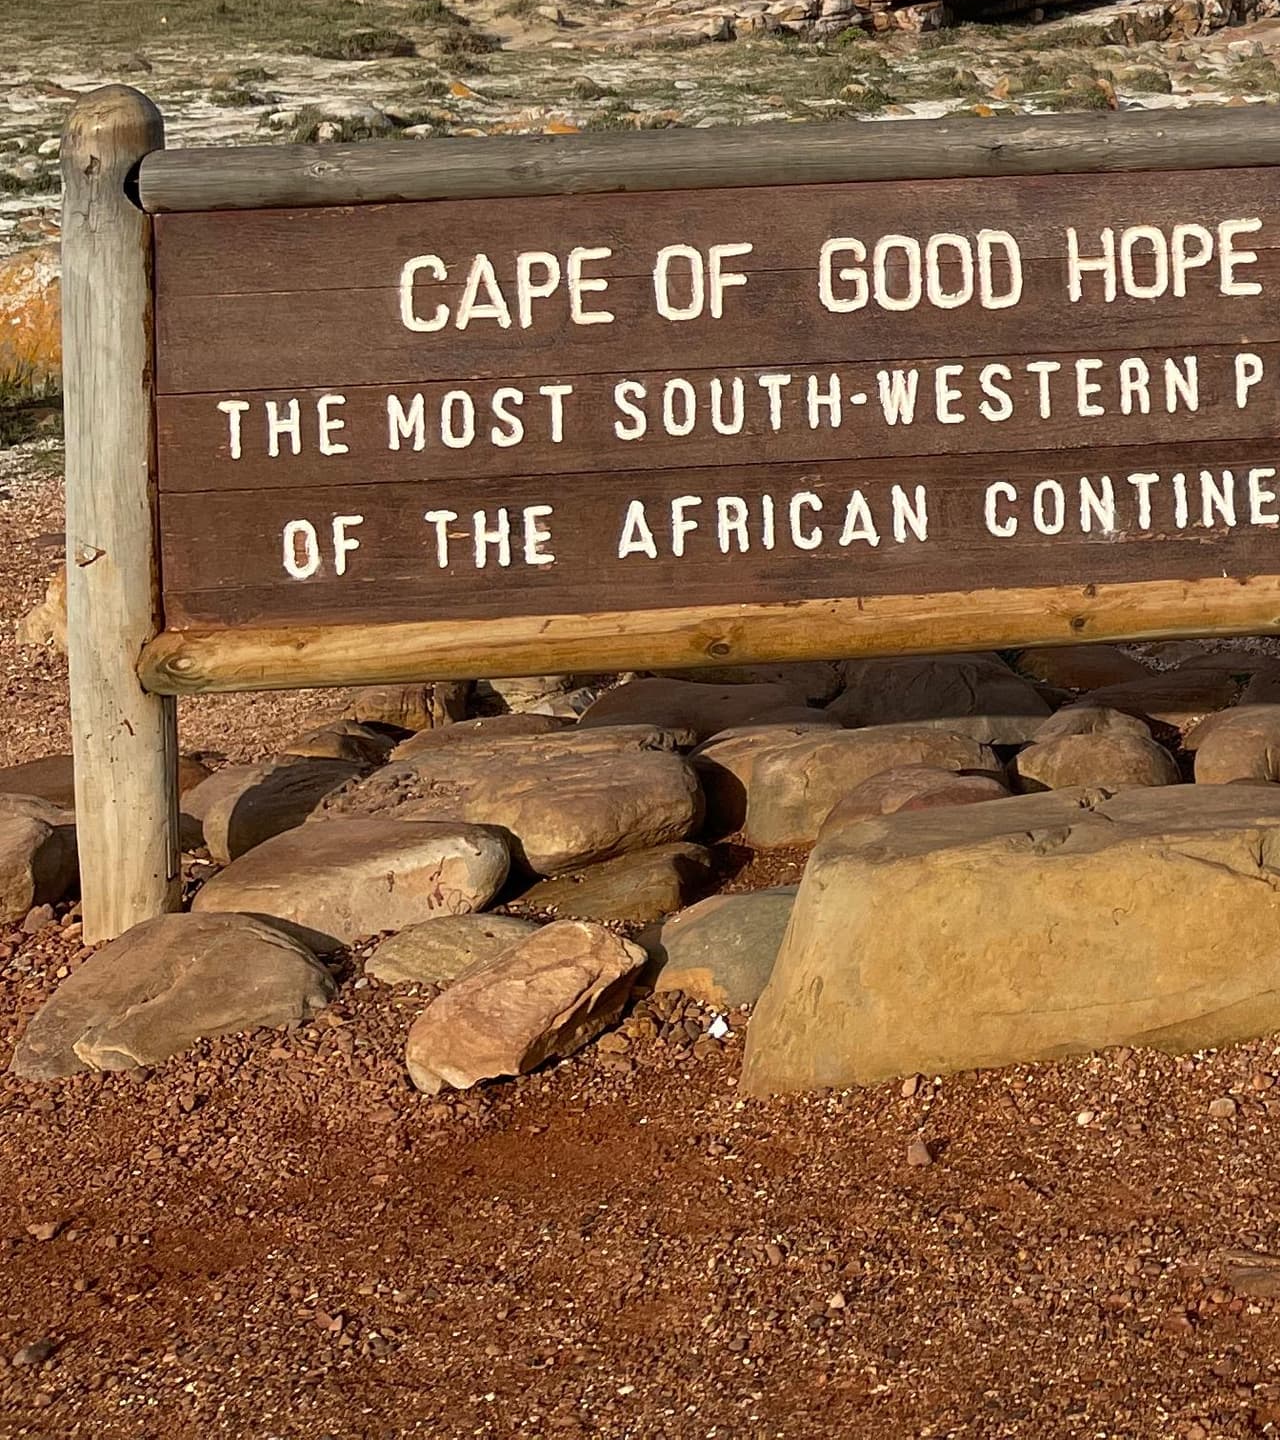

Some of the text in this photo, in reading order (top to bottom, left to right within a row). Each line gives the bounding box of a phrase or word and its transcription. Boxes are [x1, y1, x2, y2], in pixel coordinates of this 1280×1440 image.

[398, 216, 1264, 333] CAPE OF GOOD HOPE
[216, 393, 350, 460] THE
[386, 384, 574, 452] MOST
[613, 354, 1200, 442] SOUTH-WESTERN
[282, 514, 365, 581] OF
[423, 504, 556, 569] THE
[617, 483, 929, 560] AFRICAN
